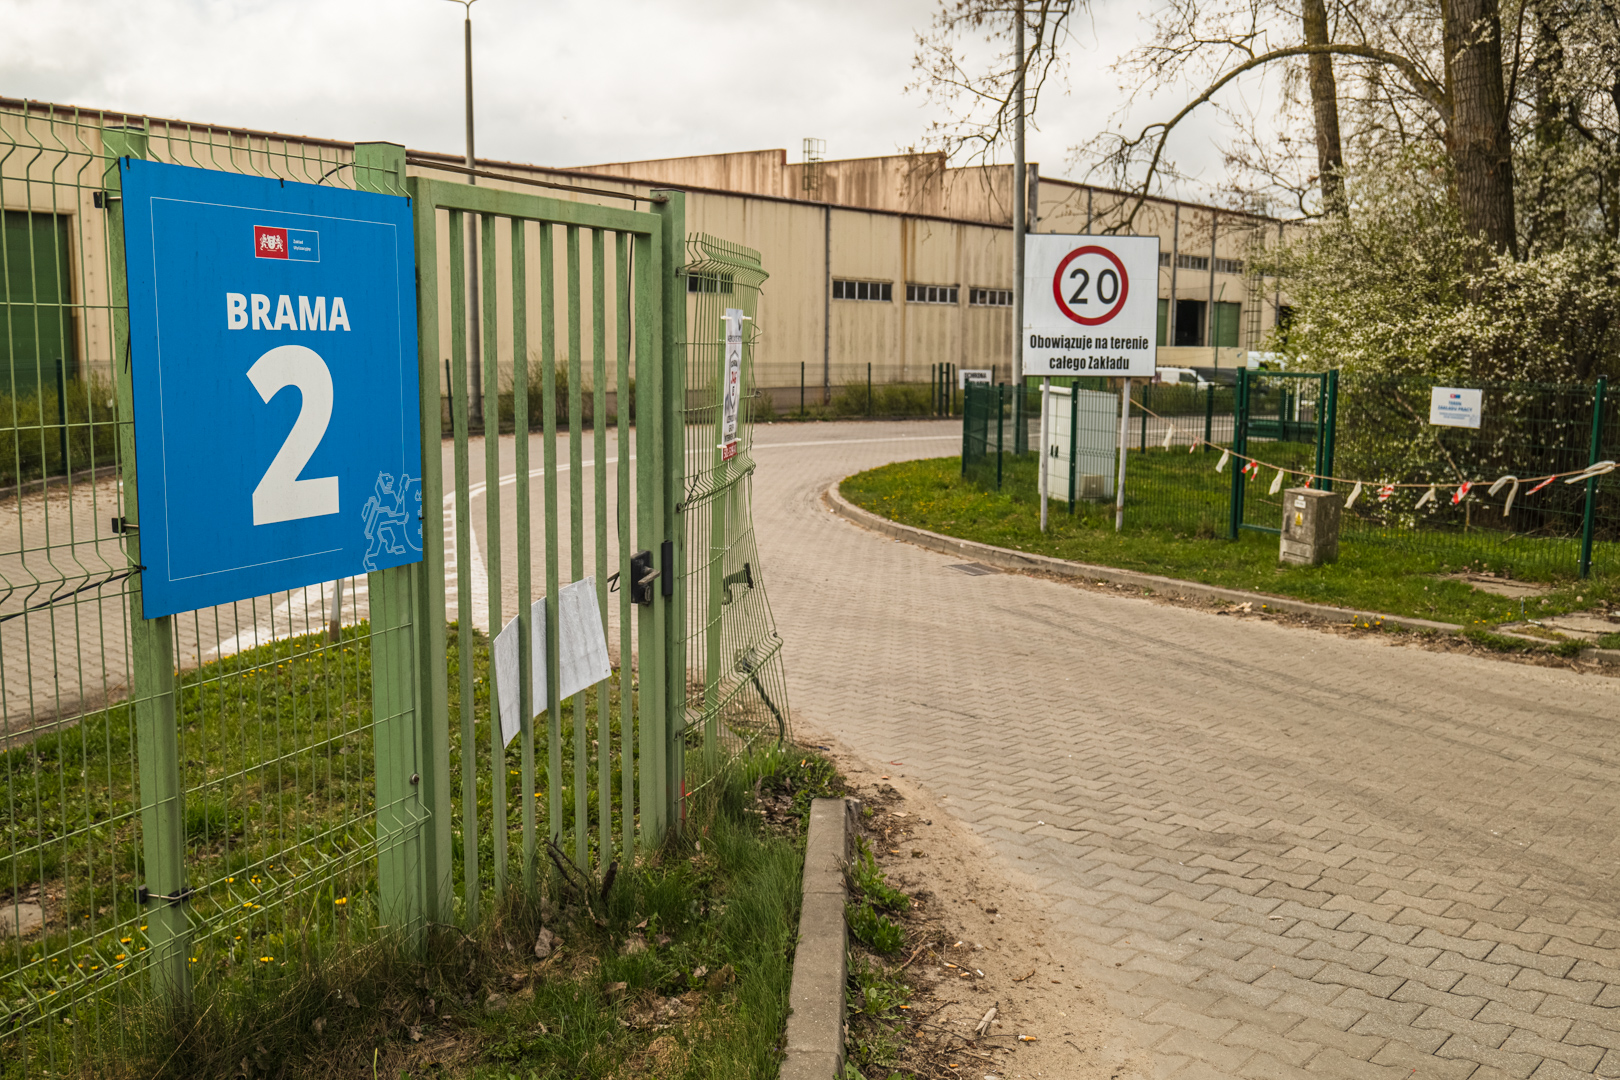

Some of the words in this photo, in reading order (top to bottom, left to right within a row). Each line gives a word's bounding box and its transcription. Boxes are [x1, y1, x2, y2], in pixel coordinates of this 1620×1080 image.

[1069, 268, 1119, 304] 20
[226, 292, 351, 332] BRAMA
[1030, 334, 1092, 352] Obowiązuje
[1094, 338, 1108, 350] na
[1110, 336, 1149, 350] terenie
[1049, 356, 1086, 371] całego
[1088, 356, 1130, 370] Zakładu
[246, 344, 340, 526] 2
